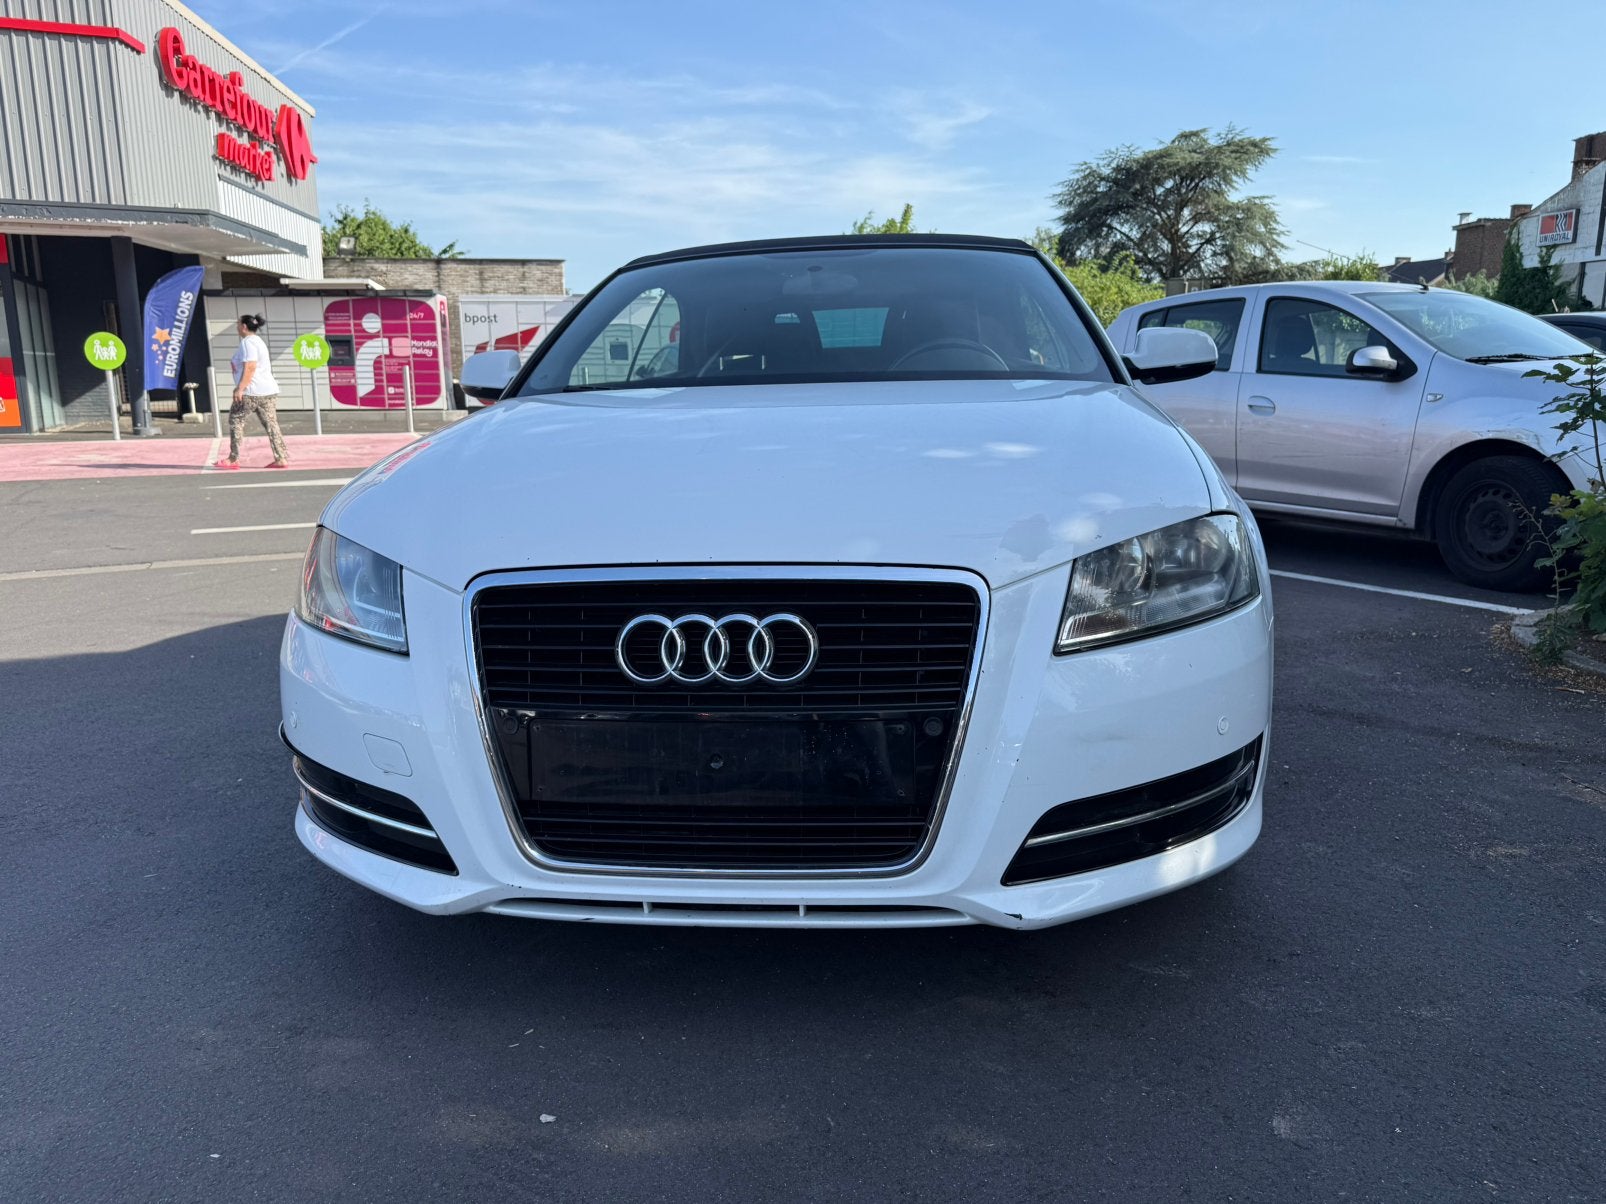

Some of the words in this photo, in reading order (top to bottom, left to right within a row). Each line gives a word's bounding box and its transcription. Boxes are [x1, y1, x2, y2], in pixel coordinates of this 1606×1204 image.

[159, 27, 275, 141] Carrefour
[216, 132, 275, 181] market
[1540, 232, 1570, 243] UNIROYAL
[464, 313, 498, 325] bpost
[163, 290, 194, 378] EUROMILLIONS
[411, 339, 438, 348] Mondial
[411, 347, 433, 357] Relay
